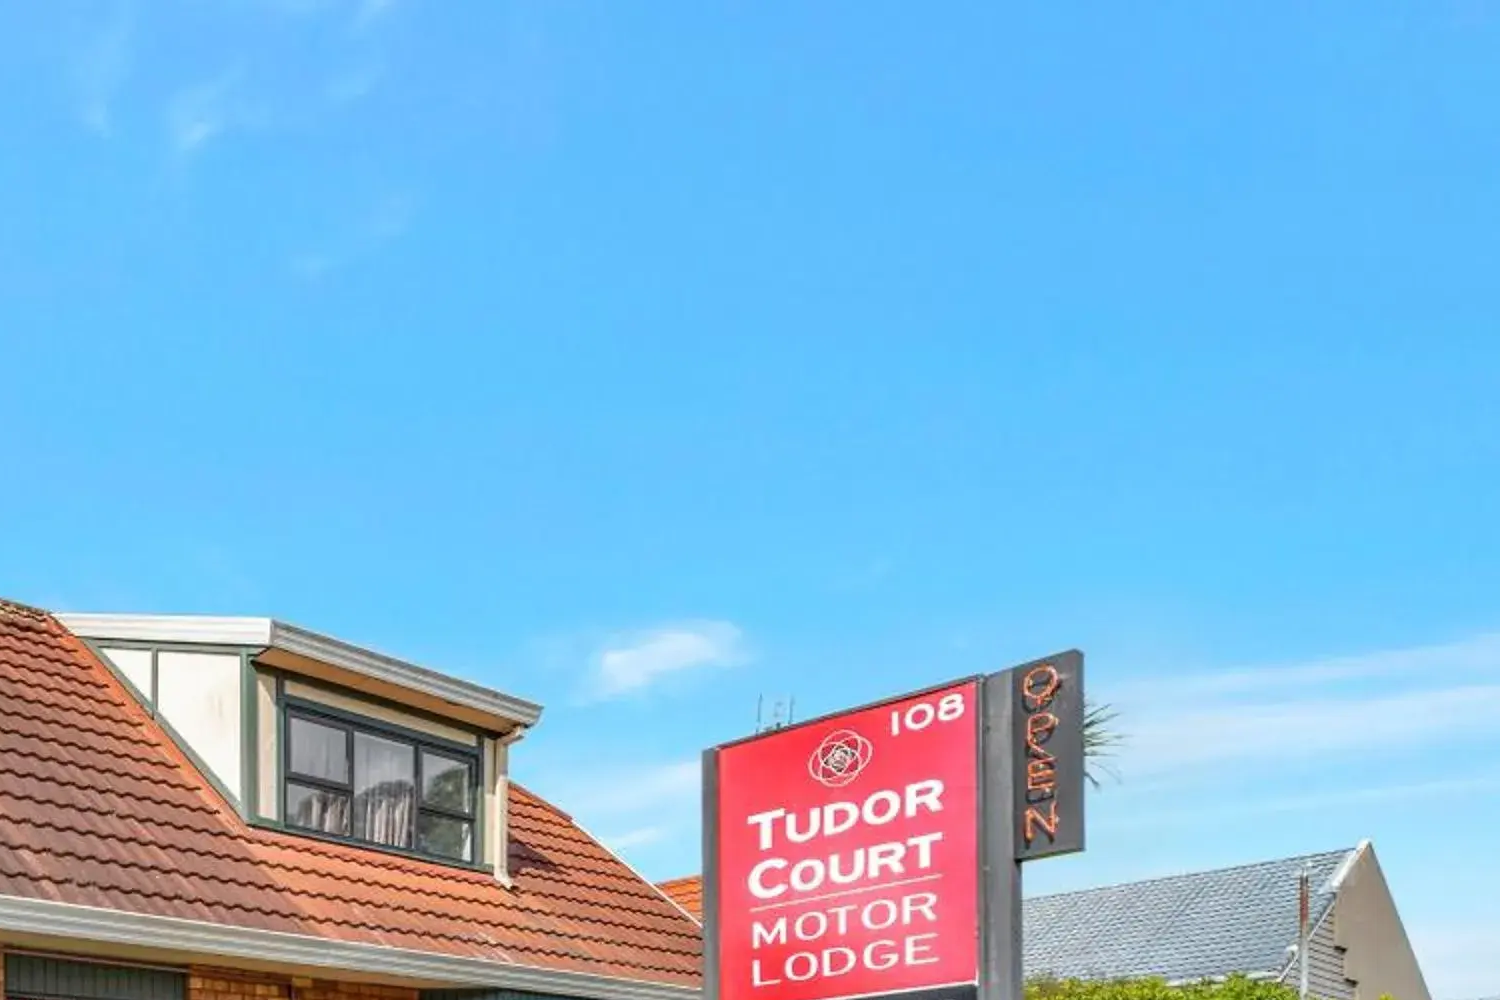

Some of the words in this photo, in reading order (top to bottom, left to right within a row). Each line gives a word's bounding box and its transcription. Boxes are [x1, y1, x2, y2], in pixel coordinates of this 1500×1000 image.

[890, 693, 965, 736] 108
[1023, 664, 1059, 844] OPEN
[747, 779, 945, 850] TUDOR
[748, 832, 944, 898] COURT
[752, 892, 938, 949] MOTOR
[752, 932, 940, 987] LODGE
